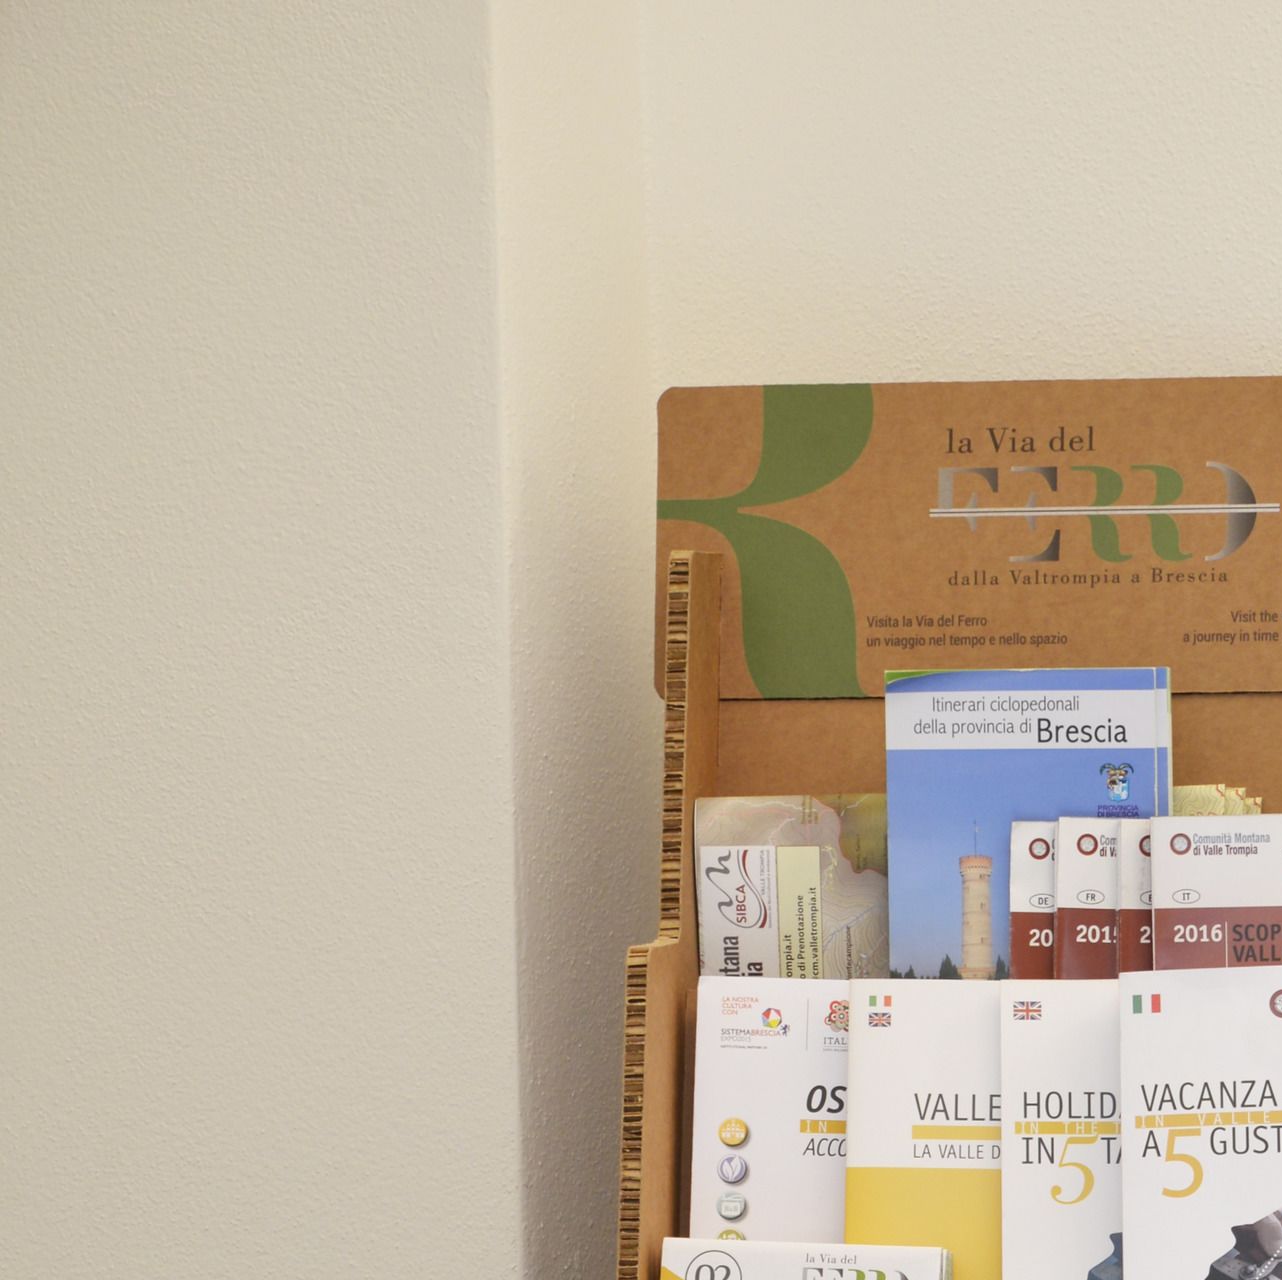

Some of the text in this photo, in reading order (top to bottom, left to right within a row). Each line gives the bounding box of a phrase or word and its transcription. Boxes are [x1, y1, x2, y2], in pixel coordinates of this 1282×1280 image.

[946, 426, 1096, 454] la Via del
[937, 461, 1257, 562] FERRO
[948, 567, 1228, 588] dalla Valtrompia a Brescia
[867, 615, 987, 627] Visita la Via del Ferro
[1231, 611, 1256, 622] Visit
[1260, 610, 1278, 622] the
[867, 633, 1067, 649] un viaggio nel tempo e nello spazio
[1183, 634, 1189, 642] a
[1193, 631, 1236, 645] journey
[1240, 631, 1249, 642] in
[1253, 630, 1278, 641] time
[932, 696, 1079, 715] Itinerari ciclopedonali
[914, 718, 1128, 742] della provincia di Brescia
[1193, 832, 1270, 845] Comunità Montana
[1194, 844, 1258, 857] di Valle Trompia
[736, 885, 747, 923] SIBCA
[1038, 897, 1049, 905] DE
[1086, 893, 1096, 901] FR
[1183, 892, 1190, 901] IT
[796, 895, 806, 960] Prenotazione
[1174, 925, 1222, 942] 2016
[797, 961, 806, 972] di
[1141, 1080, 1278, 1112] VACANZA
[914, 1093, 1002, 1121] VALLE
[1023, 1091, 1122, 1120] HOLID
[806, 1120, 827, 1133] IN
[1141, 1117, 1164, 1128] IN
[1198, 1113, 1270, 1125] VALLE
[914, 1144, 931, 1158] LA
[939, 1144, 984, 1159] VALLE
[1022, 1133, 1097, 1205] IN 5
[1142, 1130, 1161, 1157] A
[1162, 1128, 1203, 1198] 5
[806, 1253, 857, 1264] la Via del
